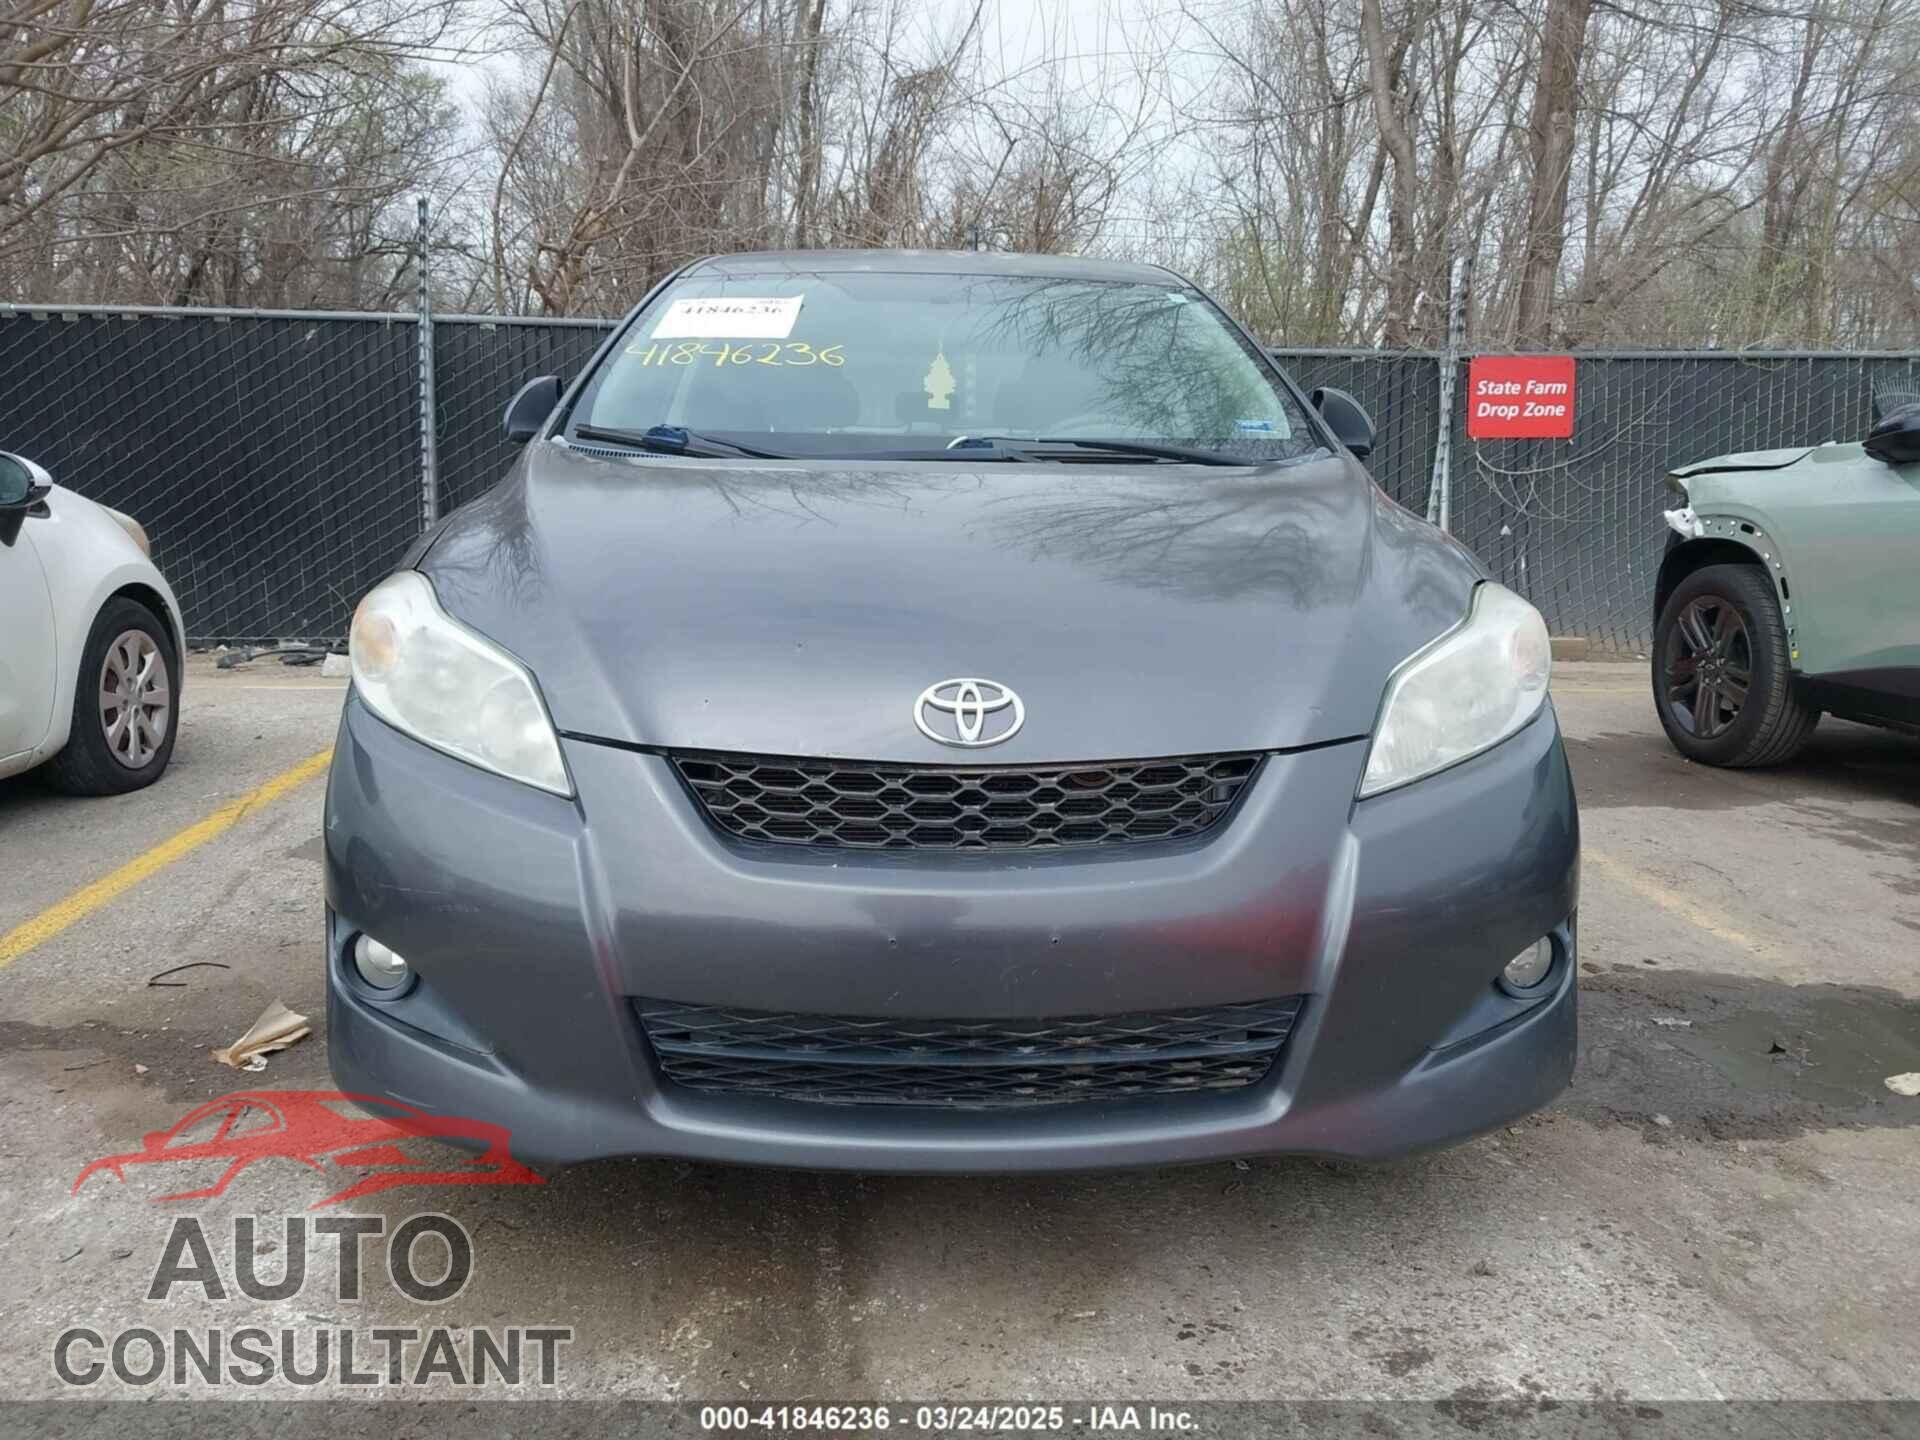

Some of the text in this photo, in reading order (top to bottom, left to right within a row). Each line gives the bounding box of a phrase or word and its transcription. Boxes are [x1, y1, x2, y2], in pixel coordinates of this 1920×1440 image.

[624, 342, 846, 367] 41846236
[1476, 380, 1568, 396] State Farm
[1476, 402, 1567, 421] Drop Zone
